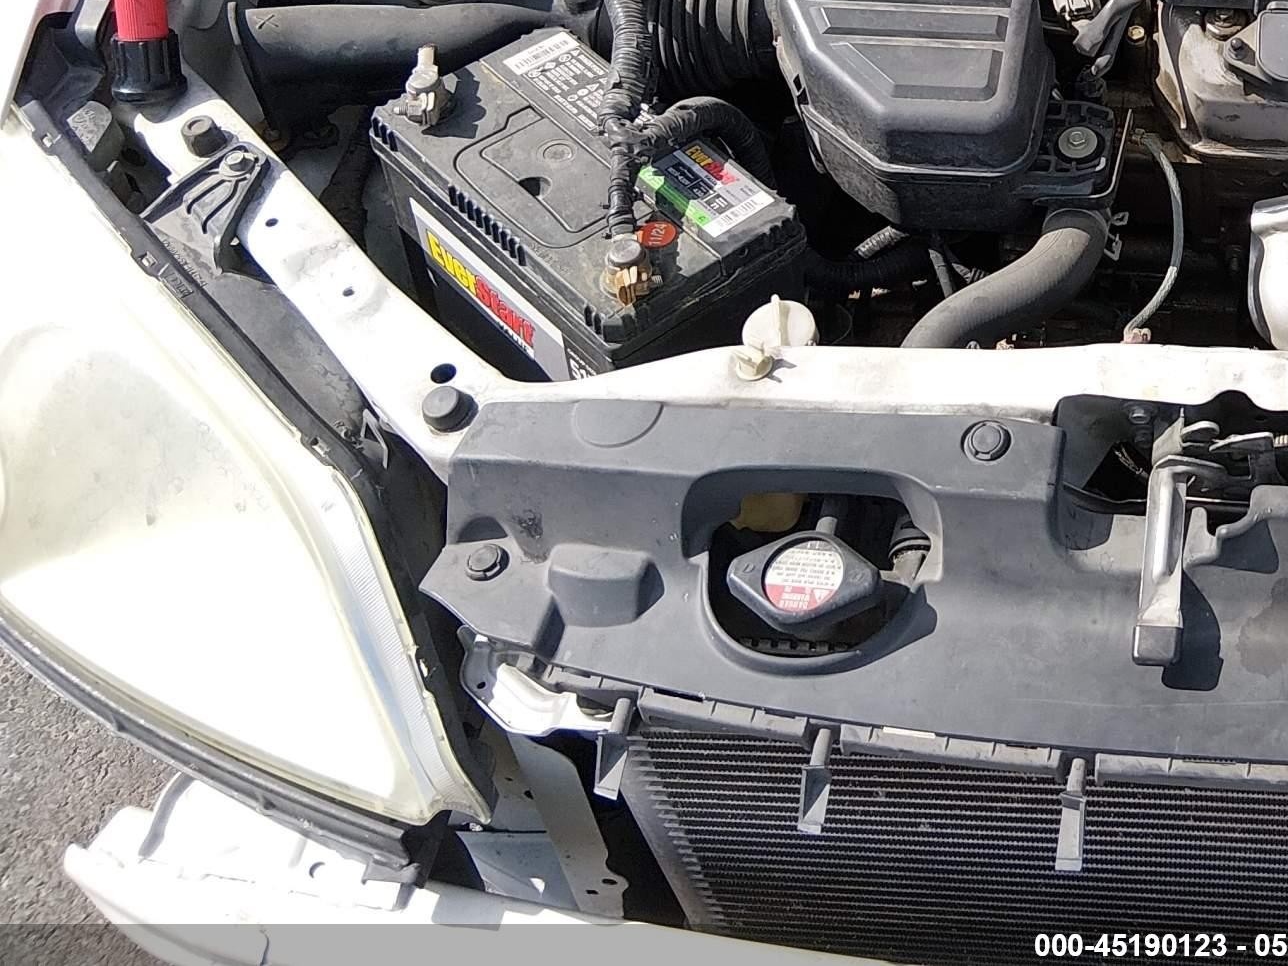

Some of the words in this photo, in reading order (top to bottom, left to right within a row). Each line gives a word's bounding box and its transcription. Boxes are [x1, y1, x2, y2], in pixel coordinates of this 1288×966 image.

[685, 144, 737, 186] EverStart
[648, 222, 668, 246] 11/24
[426, 228, 536, 348] EverStart
